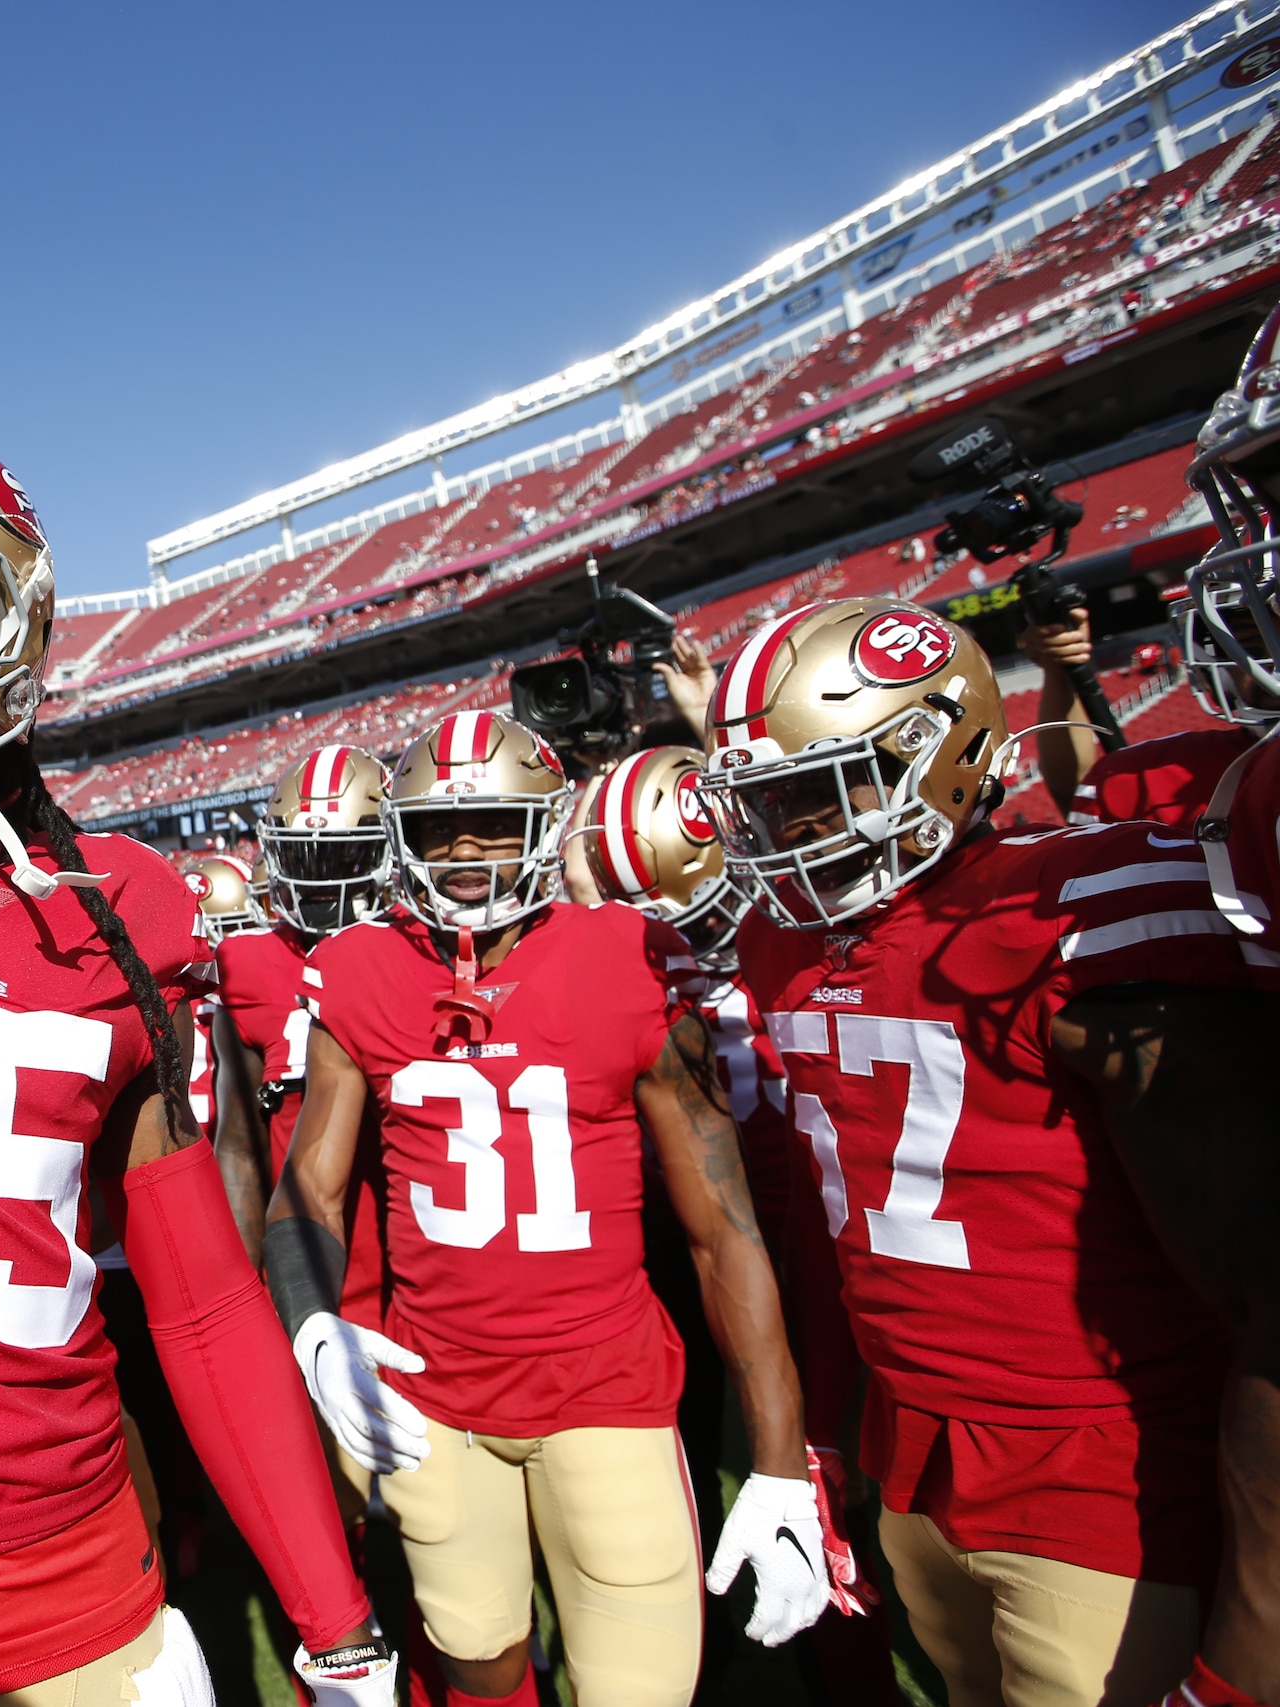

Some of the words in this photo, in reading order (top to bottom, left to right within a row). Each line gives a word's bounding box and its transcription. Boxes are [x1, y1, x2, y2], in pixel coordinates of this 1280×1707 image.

[1025, 255, 1147, 323] SUPER
[1153, 205, 1275, 265] BOWL
[170, 801, 191, 814] SAN
[191, 790, 248, 811] FRANCISCO
[809, 987, 863, 1005] 49ERS
[445, 1043, 519, 1060] 49ERS
[391, 1060, 593, 1253] 31
[325, 1646, 378, 1666] PERSONAL
